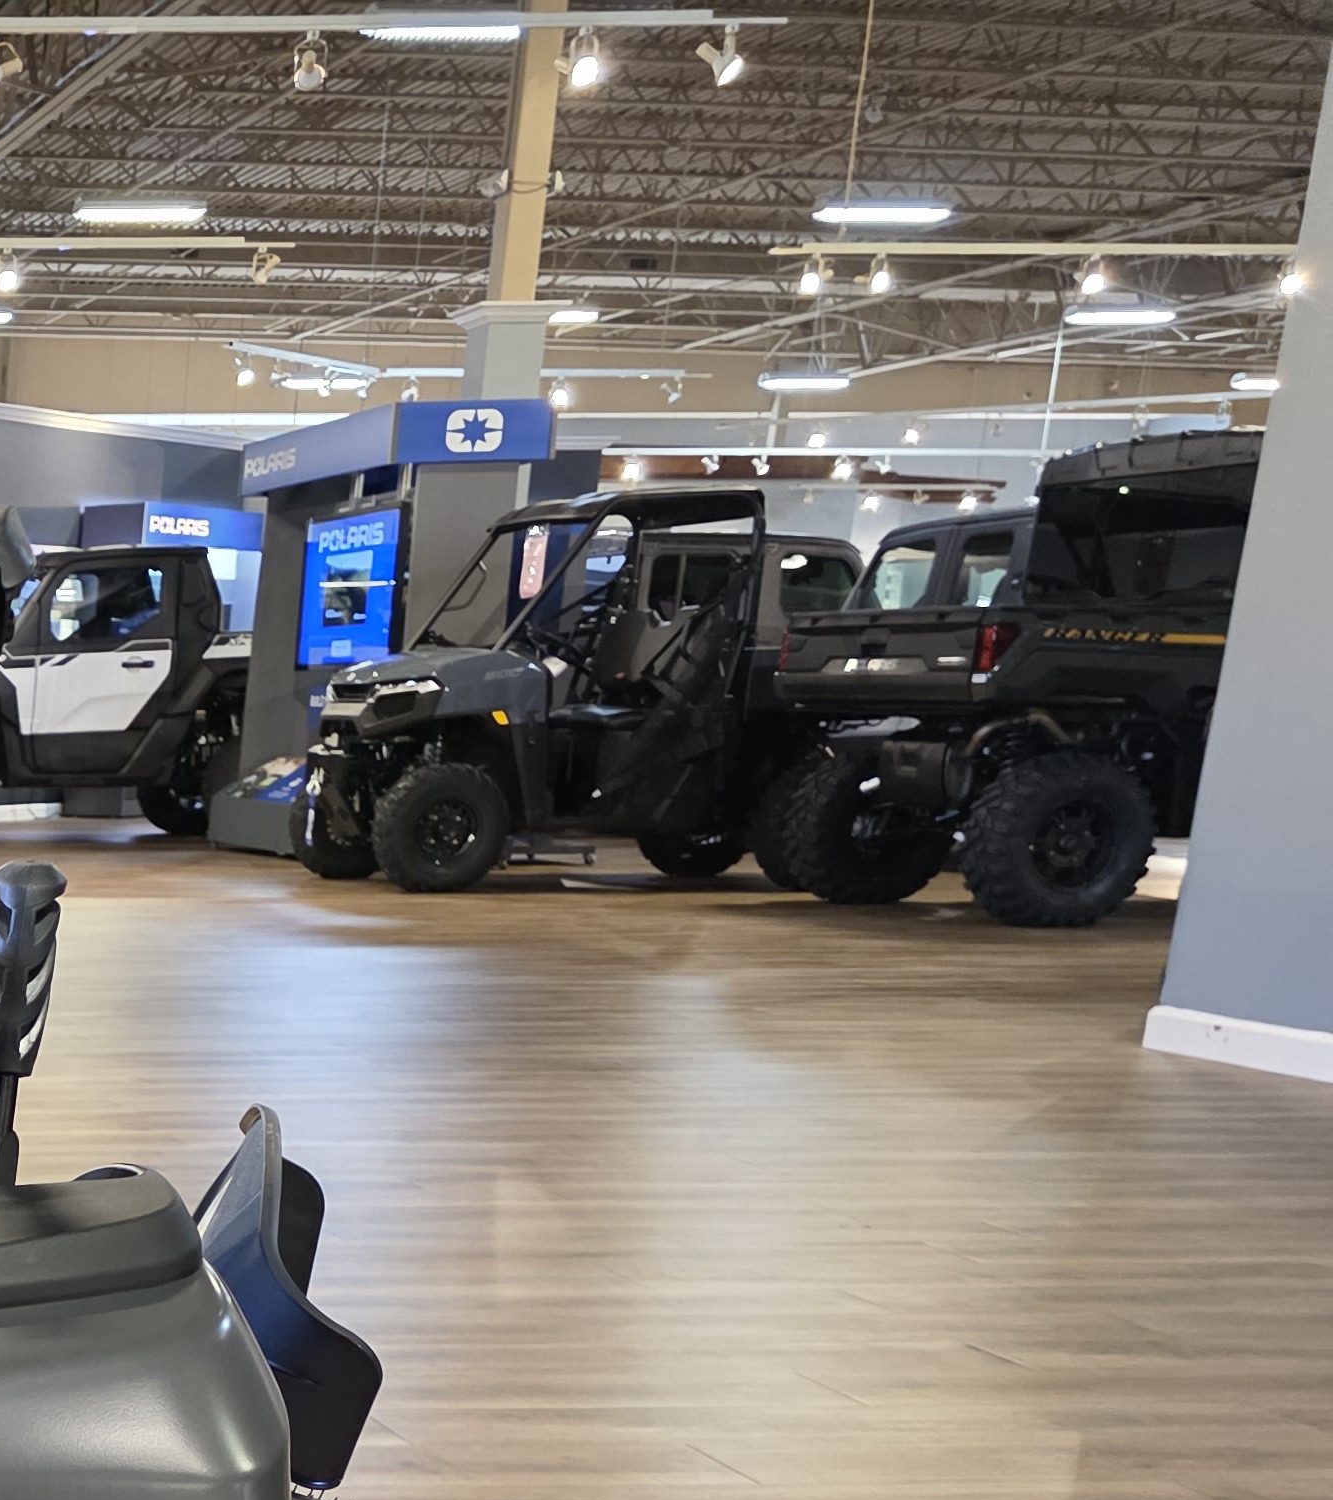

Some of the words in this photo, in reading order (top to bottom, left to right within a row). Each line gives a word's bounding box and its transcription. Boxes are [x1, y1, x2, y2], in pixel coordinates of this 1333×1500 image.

[244, 448, 296, 479] POLARIS
[149, 515, 210, 537] POLARIS
[319, 522, 384, 552] POLARIS
